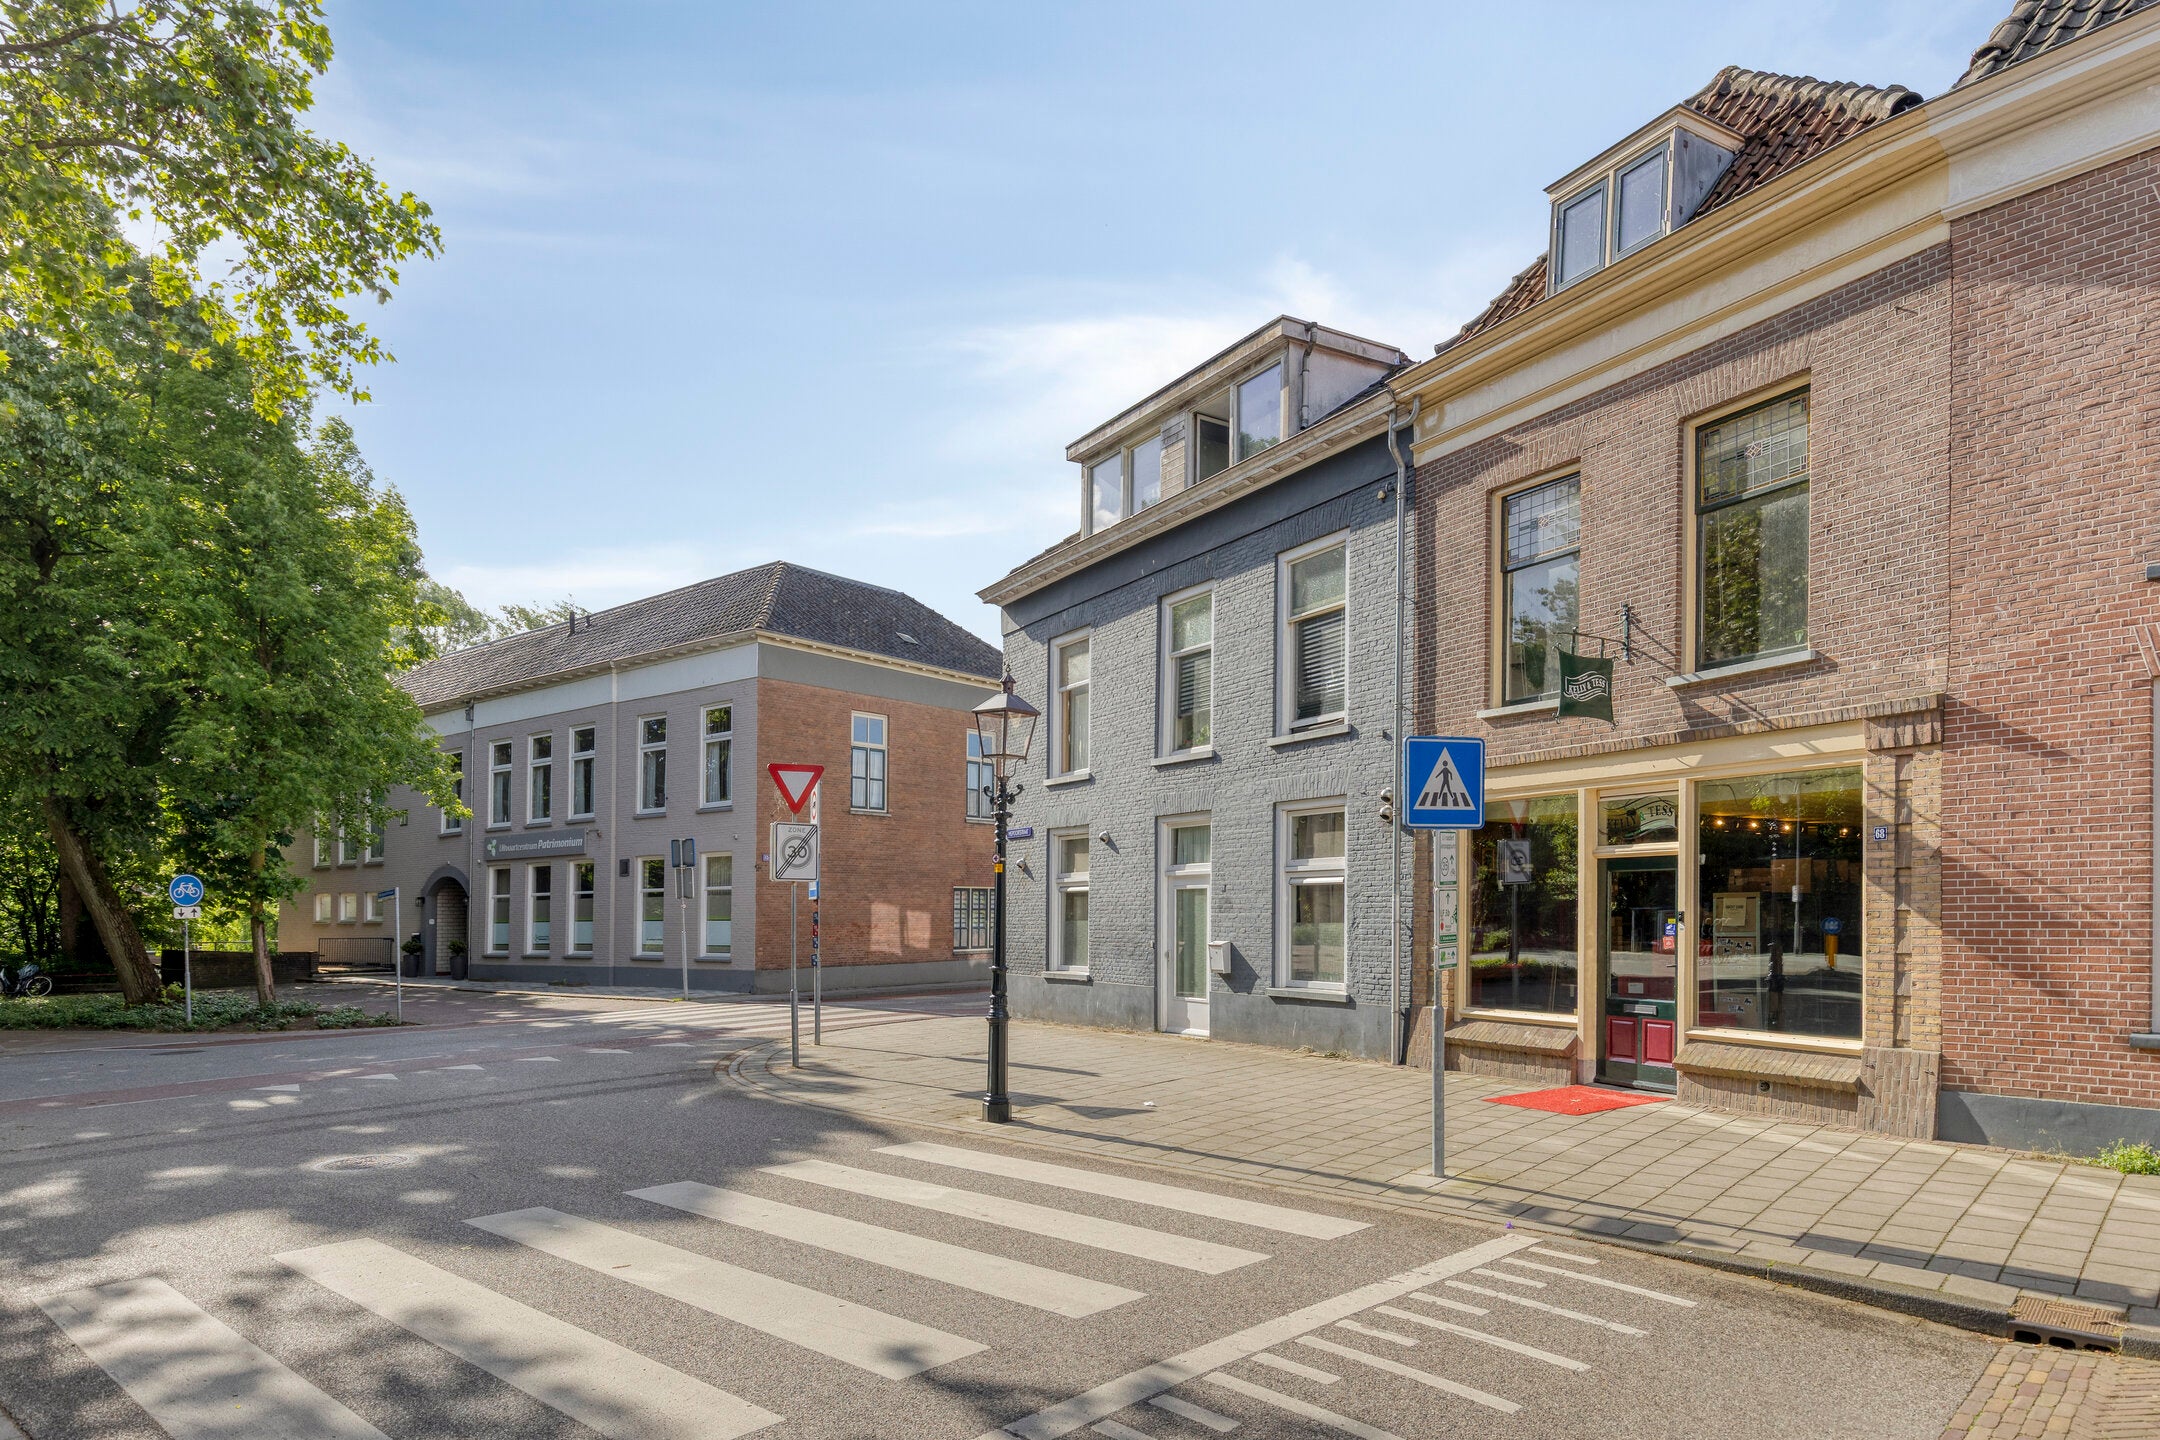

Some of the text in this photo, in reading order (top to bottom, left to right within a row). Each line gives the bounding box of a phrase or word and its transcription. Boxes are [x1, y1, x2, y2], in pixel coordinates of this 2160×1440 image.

[1568, 678, 1606, 694] KELLY & TESS
[1648, 804, 1674, 817] TESS
[1875, 828, 1885, 839] 68
[538, 837, 583, 849] Patrimonium
[787, 845, 808, 858] 30
